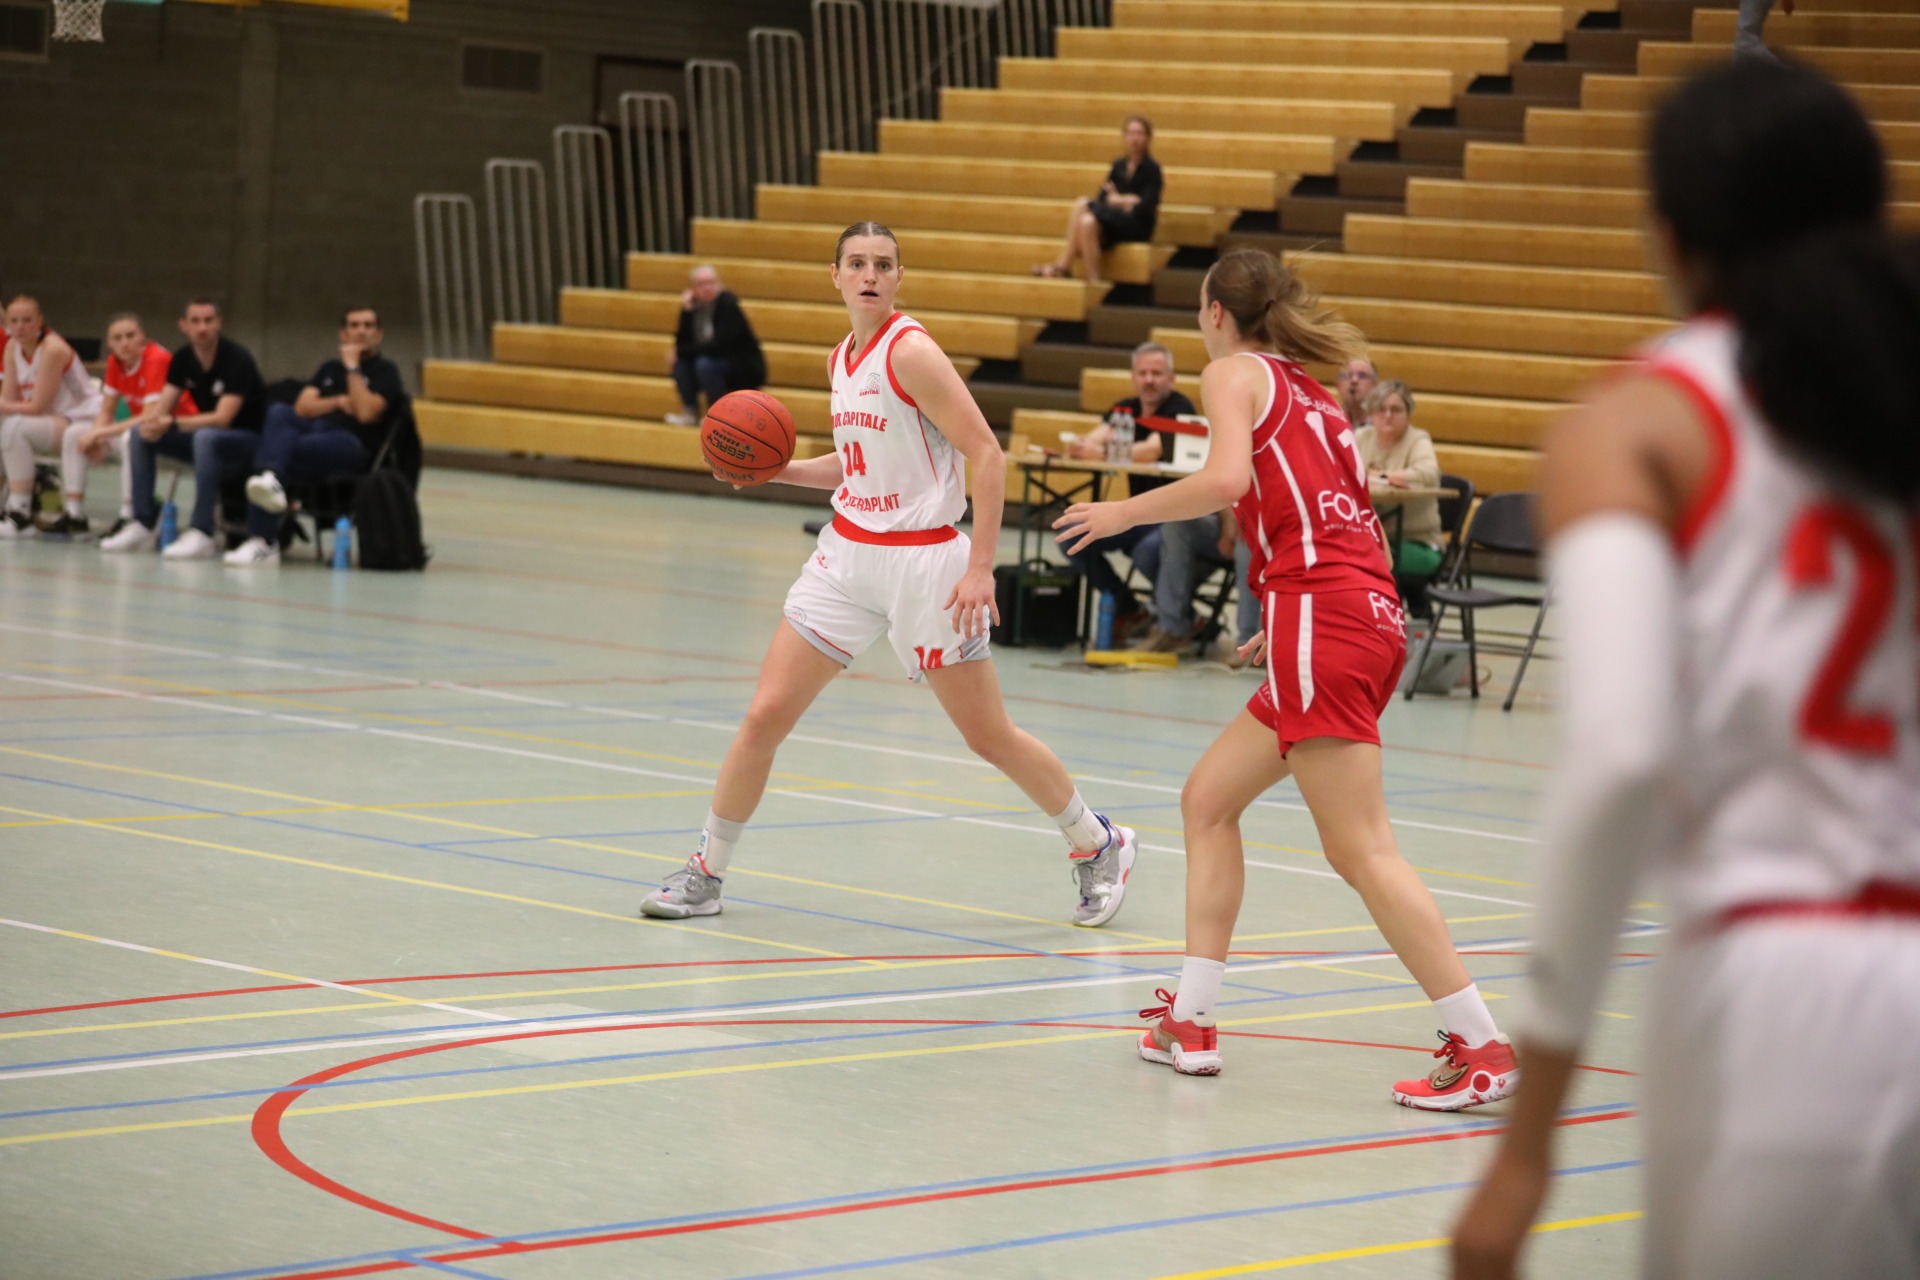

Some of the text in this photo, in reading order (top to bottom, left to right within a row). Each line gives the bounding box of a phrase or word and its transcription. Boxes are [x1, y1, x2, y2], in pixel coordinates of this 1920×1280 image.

[843, 411, 888, 432] CAPITALE
[707, 434, 755, 462] LEGACY
[843, 441, 867, 477] 14
[913, 645, 944, 671] 14
